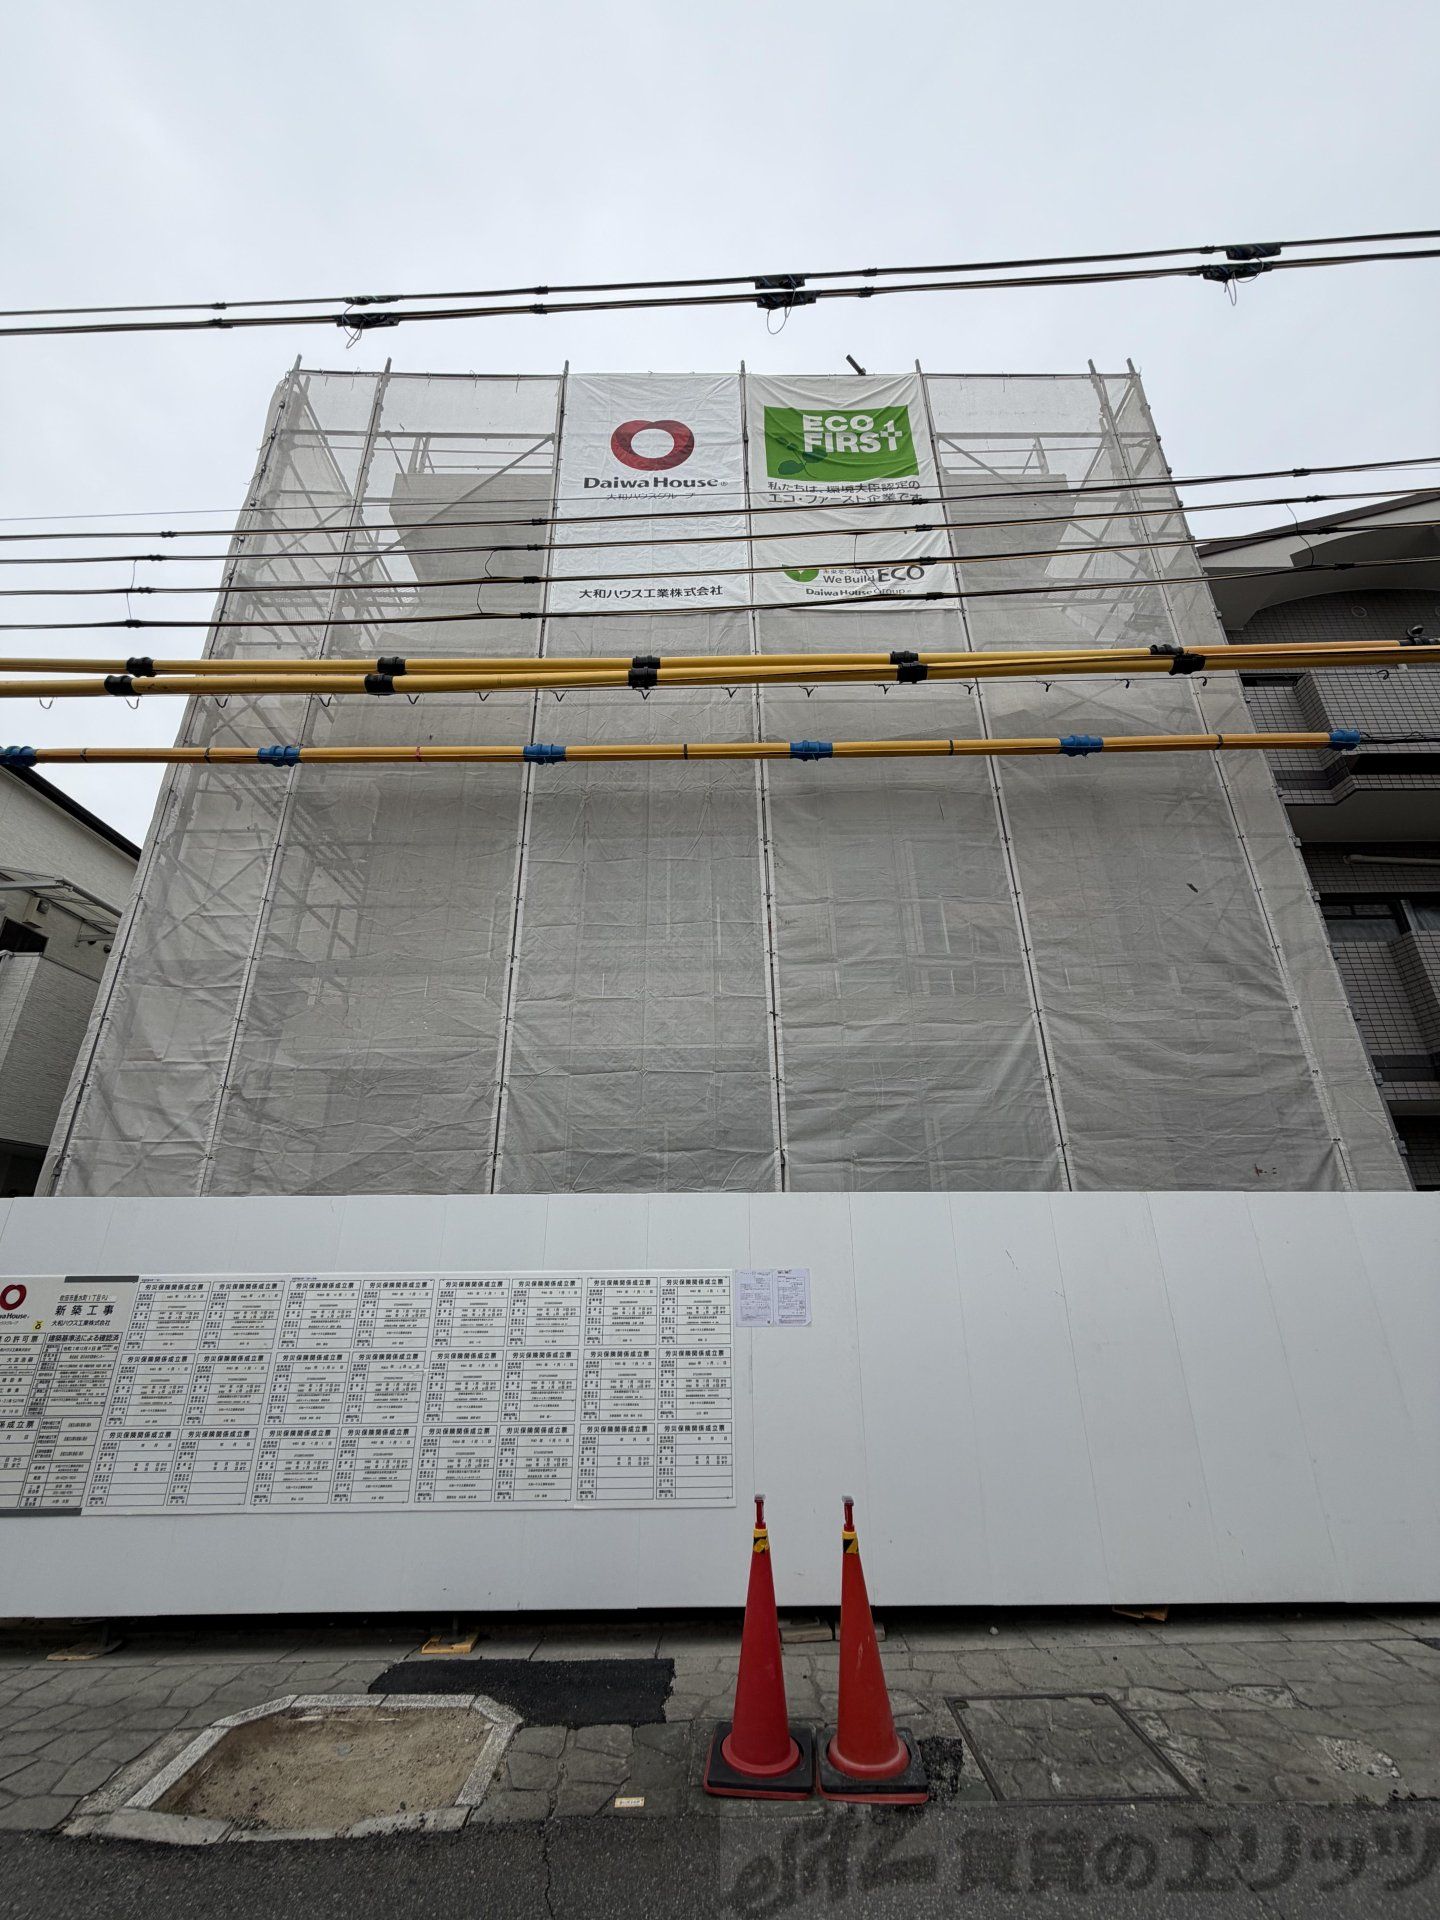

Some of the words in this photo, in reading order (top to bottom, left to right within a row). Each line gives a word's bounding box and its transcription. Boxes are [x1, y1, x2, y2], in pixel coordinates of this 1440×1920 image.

[803, 414, 875, 432] ECO
[583, 476, 650, 489] Daiwa
[653, 477, 719, 489] House
[823, 575, 842, 583] We
[844, 574, 875, 583] Build
[878, 565, 925, 583] ECO
[578, 585, 724, 599] 大和ハウス工業株式会社
[805, 588, 839, 597] Daiwa
[54, 1305, 115, 1316] 新築工事
